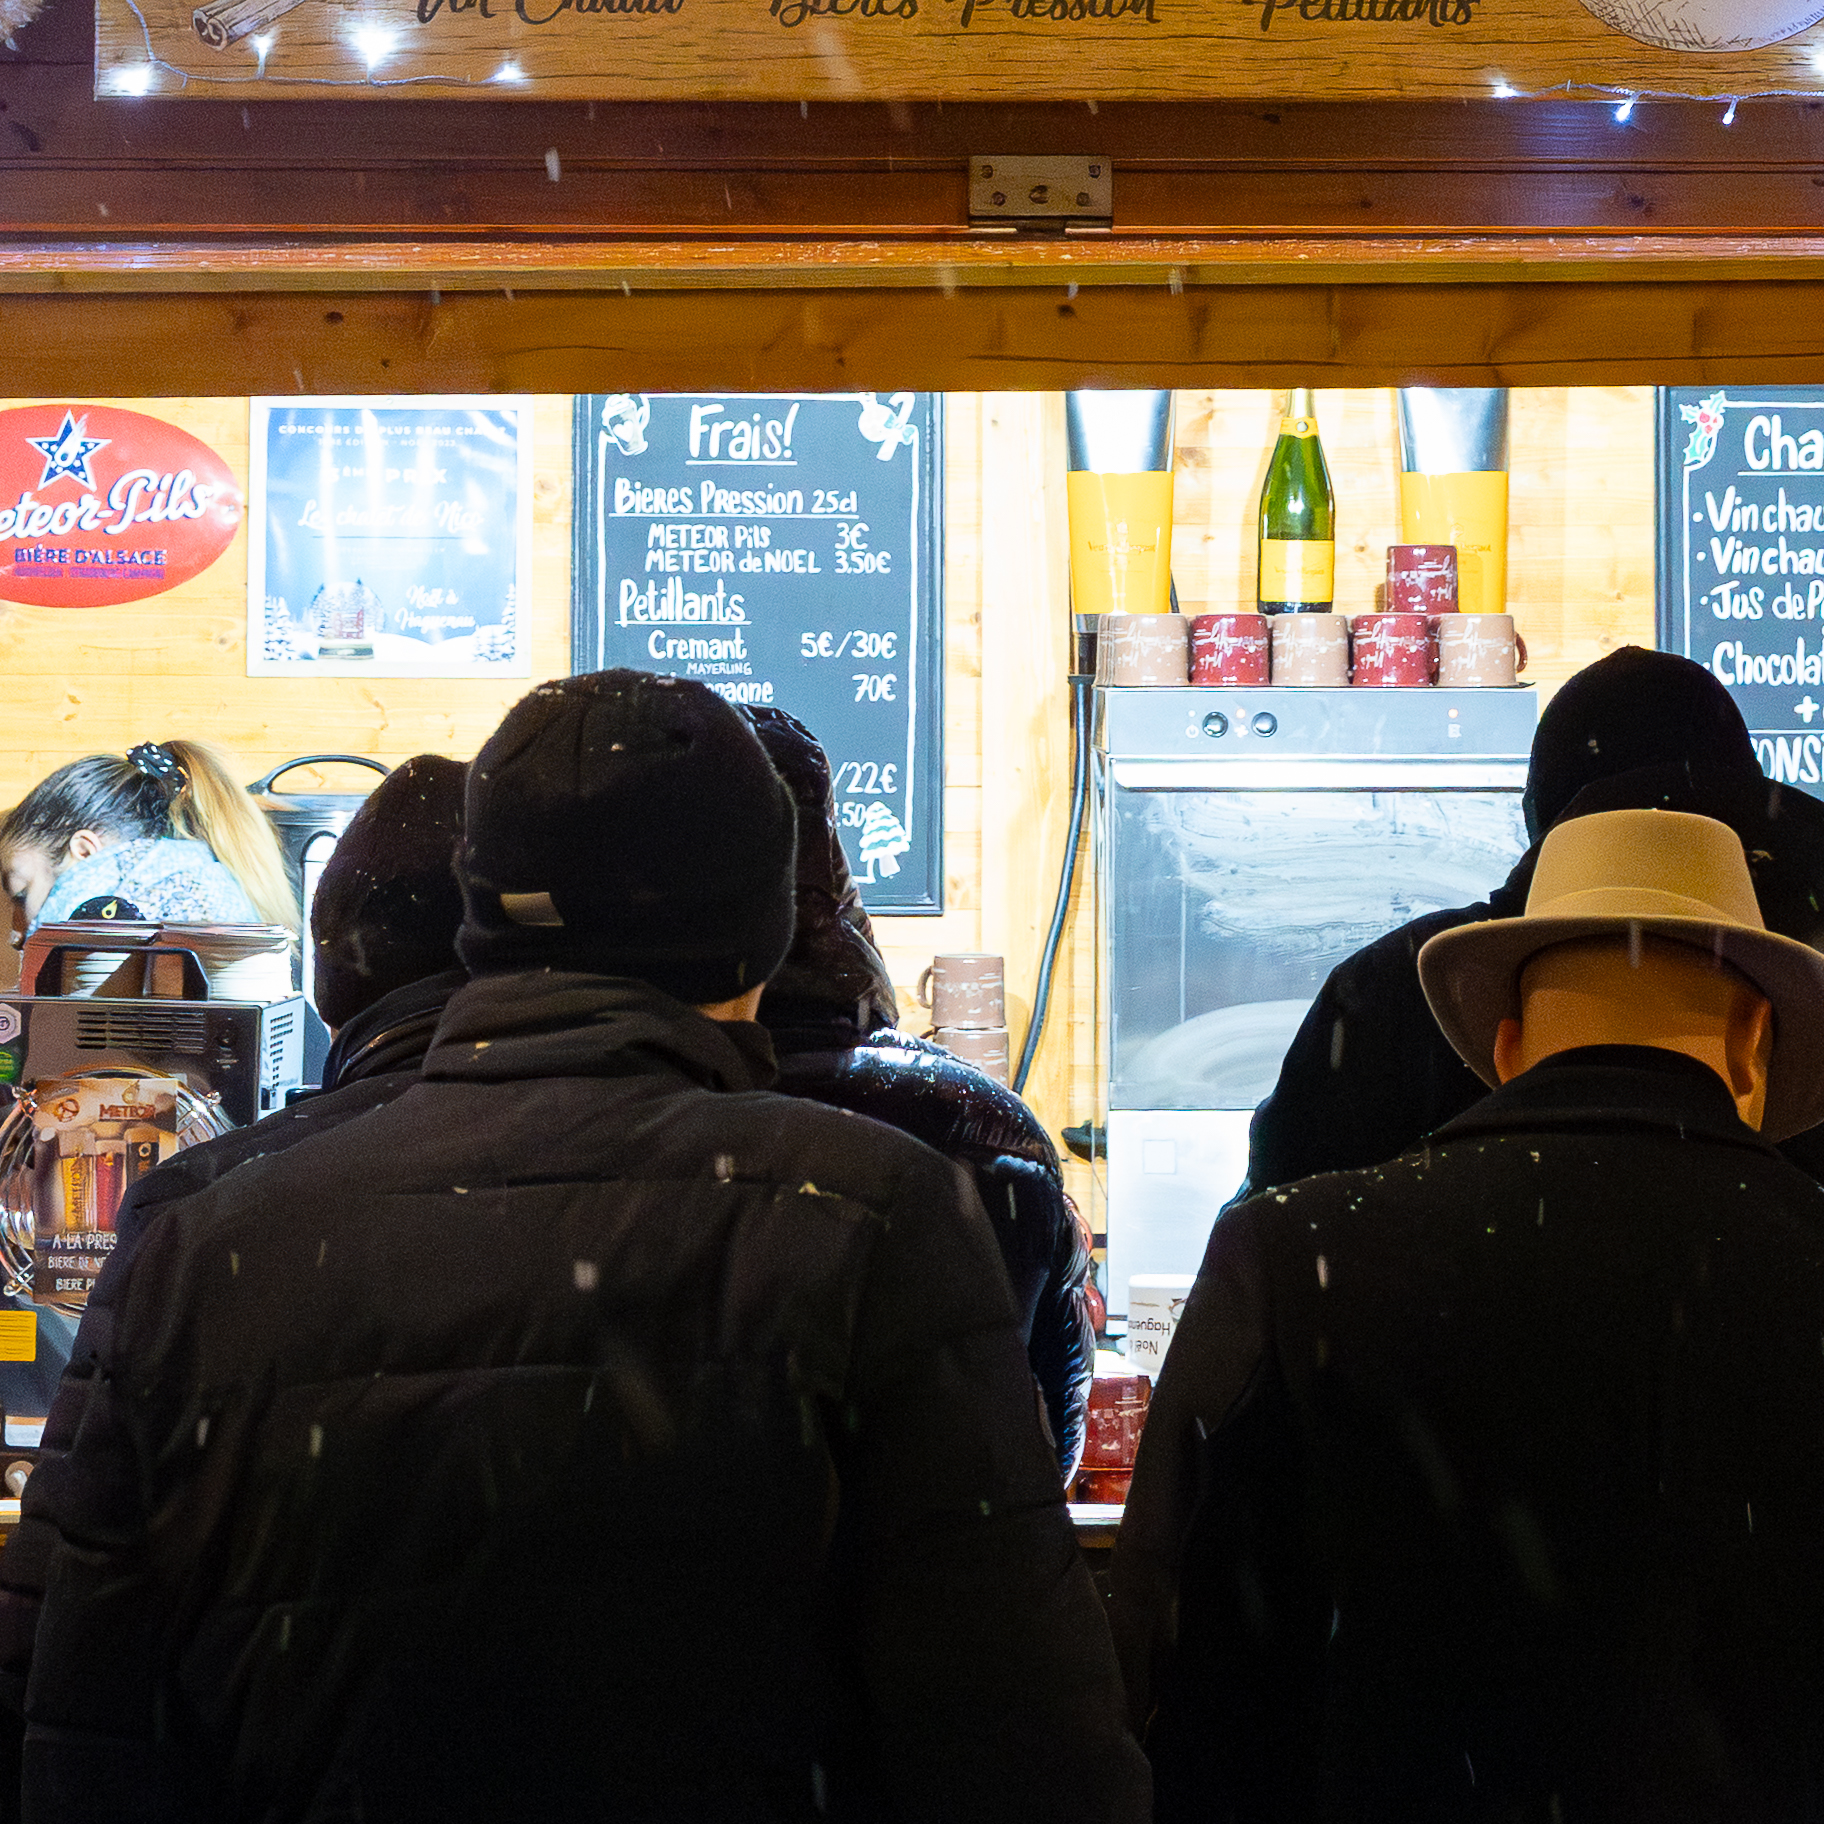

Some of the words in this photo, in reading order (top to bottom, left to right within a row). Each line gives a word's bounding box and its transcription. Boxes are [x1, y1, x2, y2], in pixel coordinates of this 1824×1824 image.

[688, 402, 801, 461] Frais!
[385, 468, 449, 485] PRX
[700, 479, 804, 515] Pression
[1705, 485, 1759, 534] Vin
[647, 524, 729, 550] METEOR
[834, 522, 870, 550] 3€
[74, 548, 167, 566] D'ALSACE
[644, 549, 735, 573] METEOR
[1710, 536, 1761, 575] Vin
[619, 576, 746, 627] Petillants
[1709, 580, 1764, 622] Jus
[647, 627, 748, 660] Cremant
[800, 630, 897, 659] 5€/30€
[686, 662, 753, 676] MAYERLING
[706, 680, 774, 703] pagne
[852, 673, 898, 702] 70€
